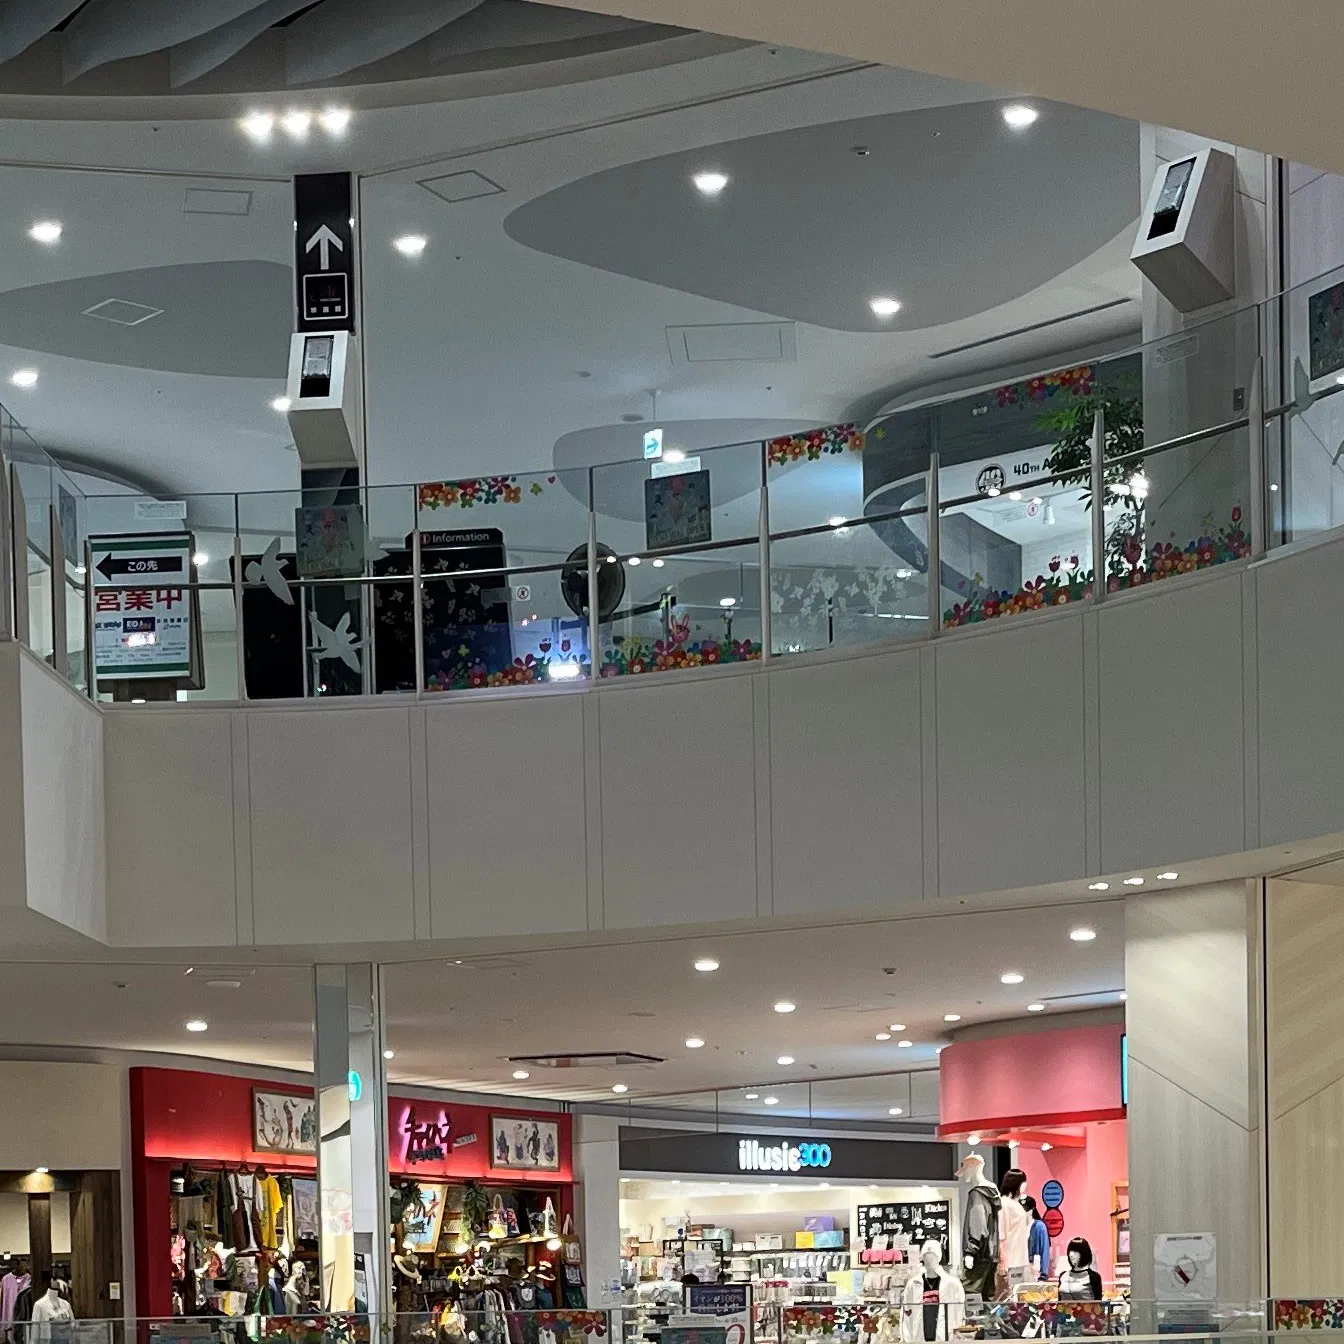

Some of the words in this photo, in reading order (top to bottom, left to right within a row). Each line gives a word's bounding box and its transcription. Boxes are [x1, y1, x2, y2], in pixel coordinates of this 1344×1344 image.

[432, 532, 490, 545] Information
[127, 560, 158, 572] この先
